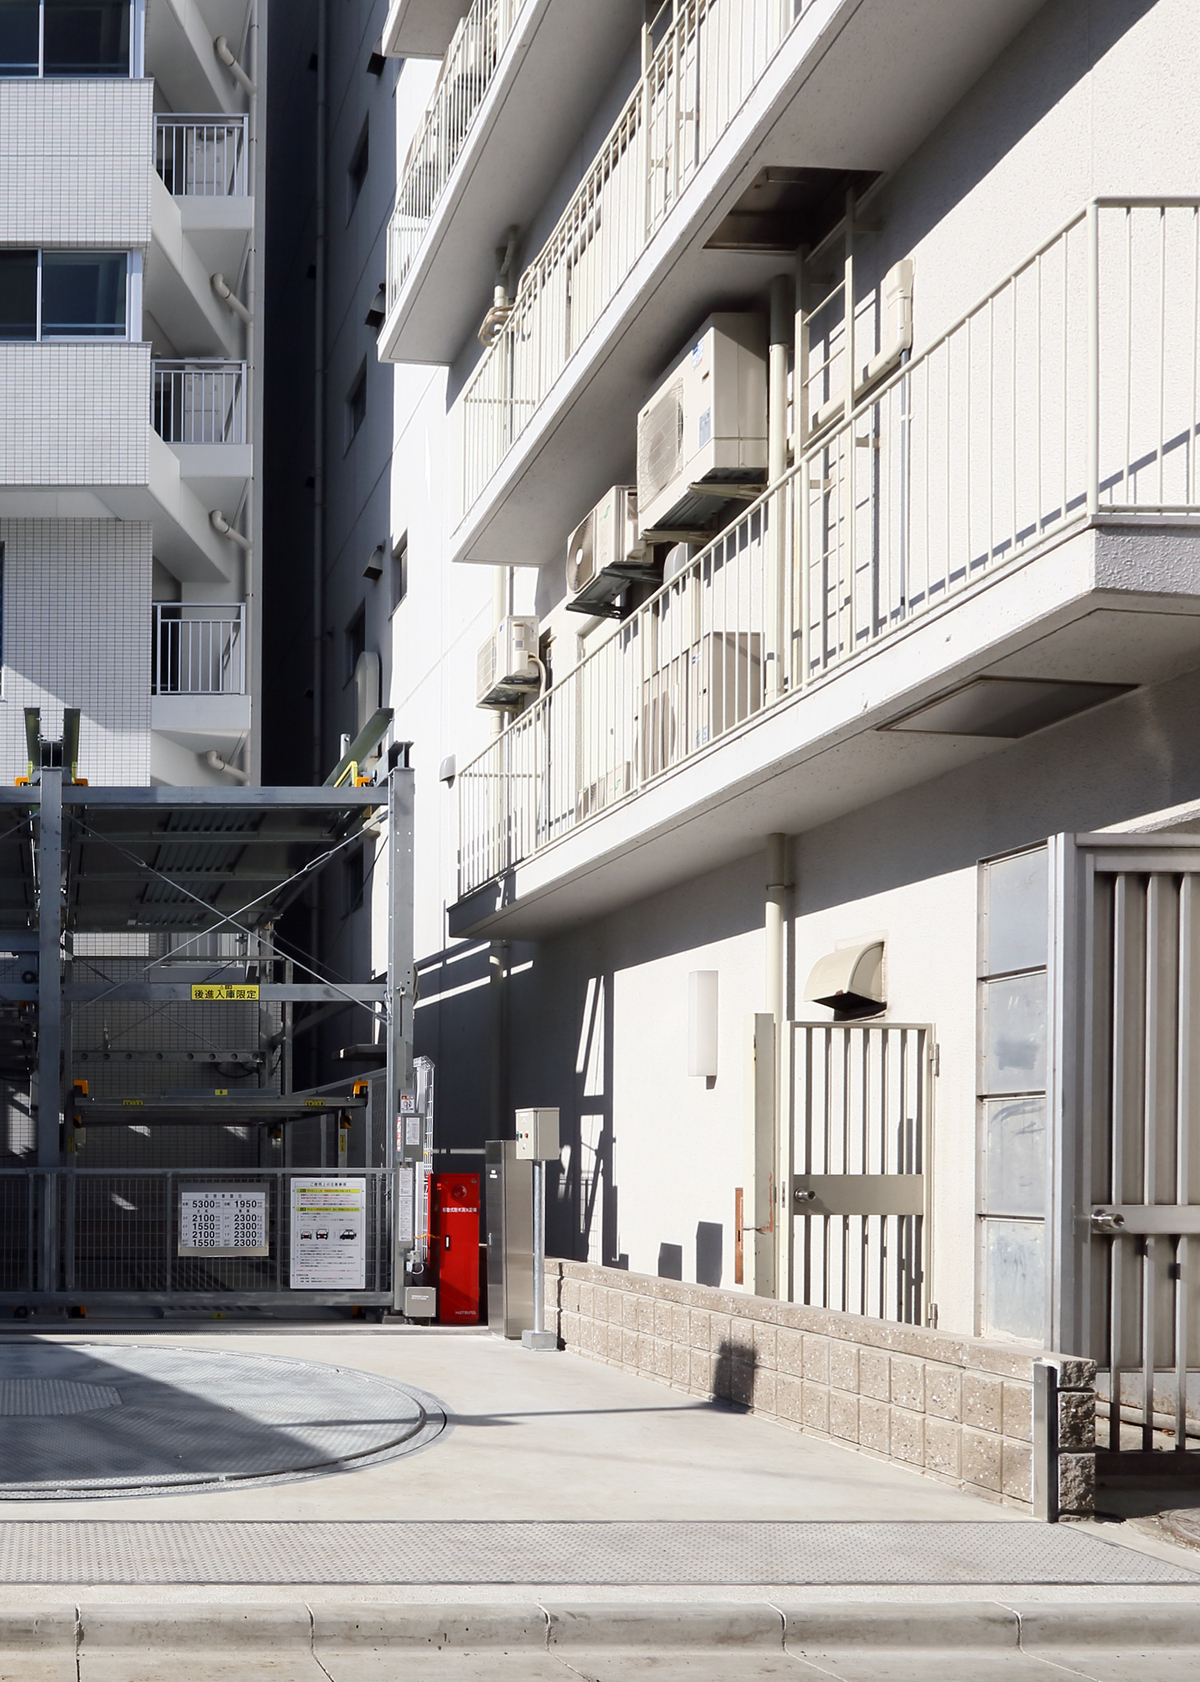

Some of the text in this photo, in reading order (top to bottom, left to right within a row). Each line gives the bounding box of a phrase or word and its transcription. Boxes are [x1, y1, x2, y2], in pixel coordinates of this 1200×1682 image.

[194, 989, 257, 999] 後進入庫限定
[192, 1200, 215, 1208] 5300
[234, 1200, 257, 1208] 1950
[192, 1214, 215, 1222] 2100
[234, 1214, 257, 1222] 2300
[192, 1222, 215, 1231] 1550
[234, 1222, 257, 1231] 2300
[192, 1230, 215, 1239] 2100
[234, 1230, 257, 1239] 2300
[192, 1239, 215, 1247] 1550
[234, 1239, 257, 1247] 2300
